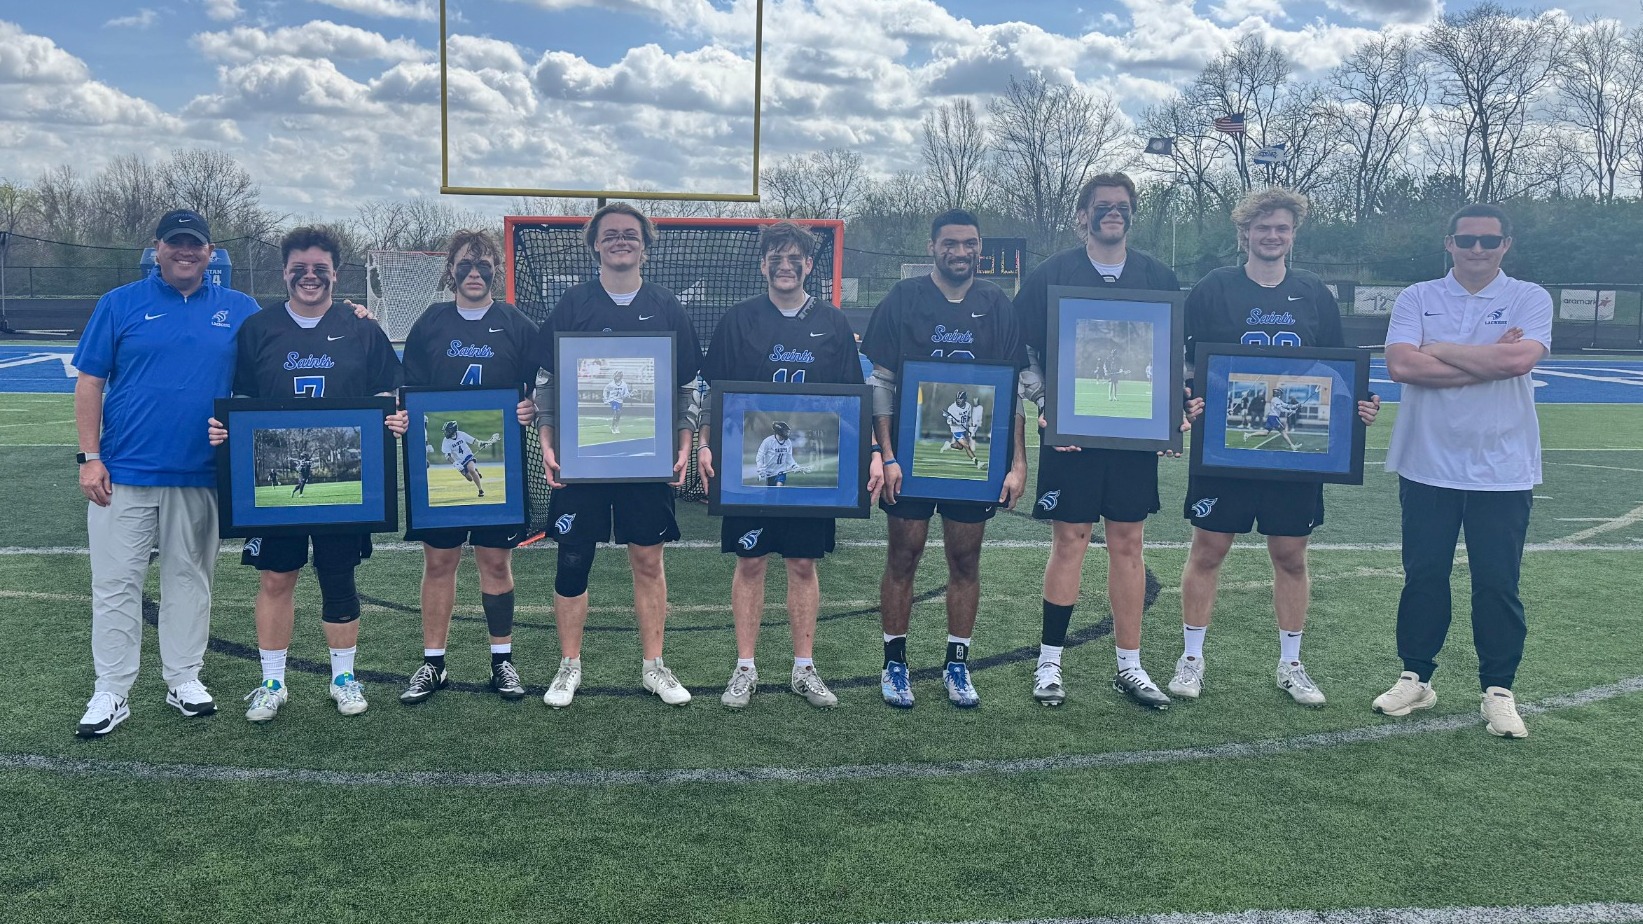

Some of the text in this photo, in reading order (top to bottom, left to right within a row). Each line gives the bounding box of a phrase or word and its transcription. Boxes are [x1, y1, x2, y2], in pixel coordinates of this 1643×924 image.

[1563, 298, 1598, 306] aramark
[1246, 307, 1296, 326] Saints
[931, 324, 975, 344] Saints
[446, 339, 495, 358] Saints
[768, 343, 816, 363] Saints
[283, 351, 335, 371] Saints
[293, 375, 325, 398] 7
[776, 453, 784, 465] 11
